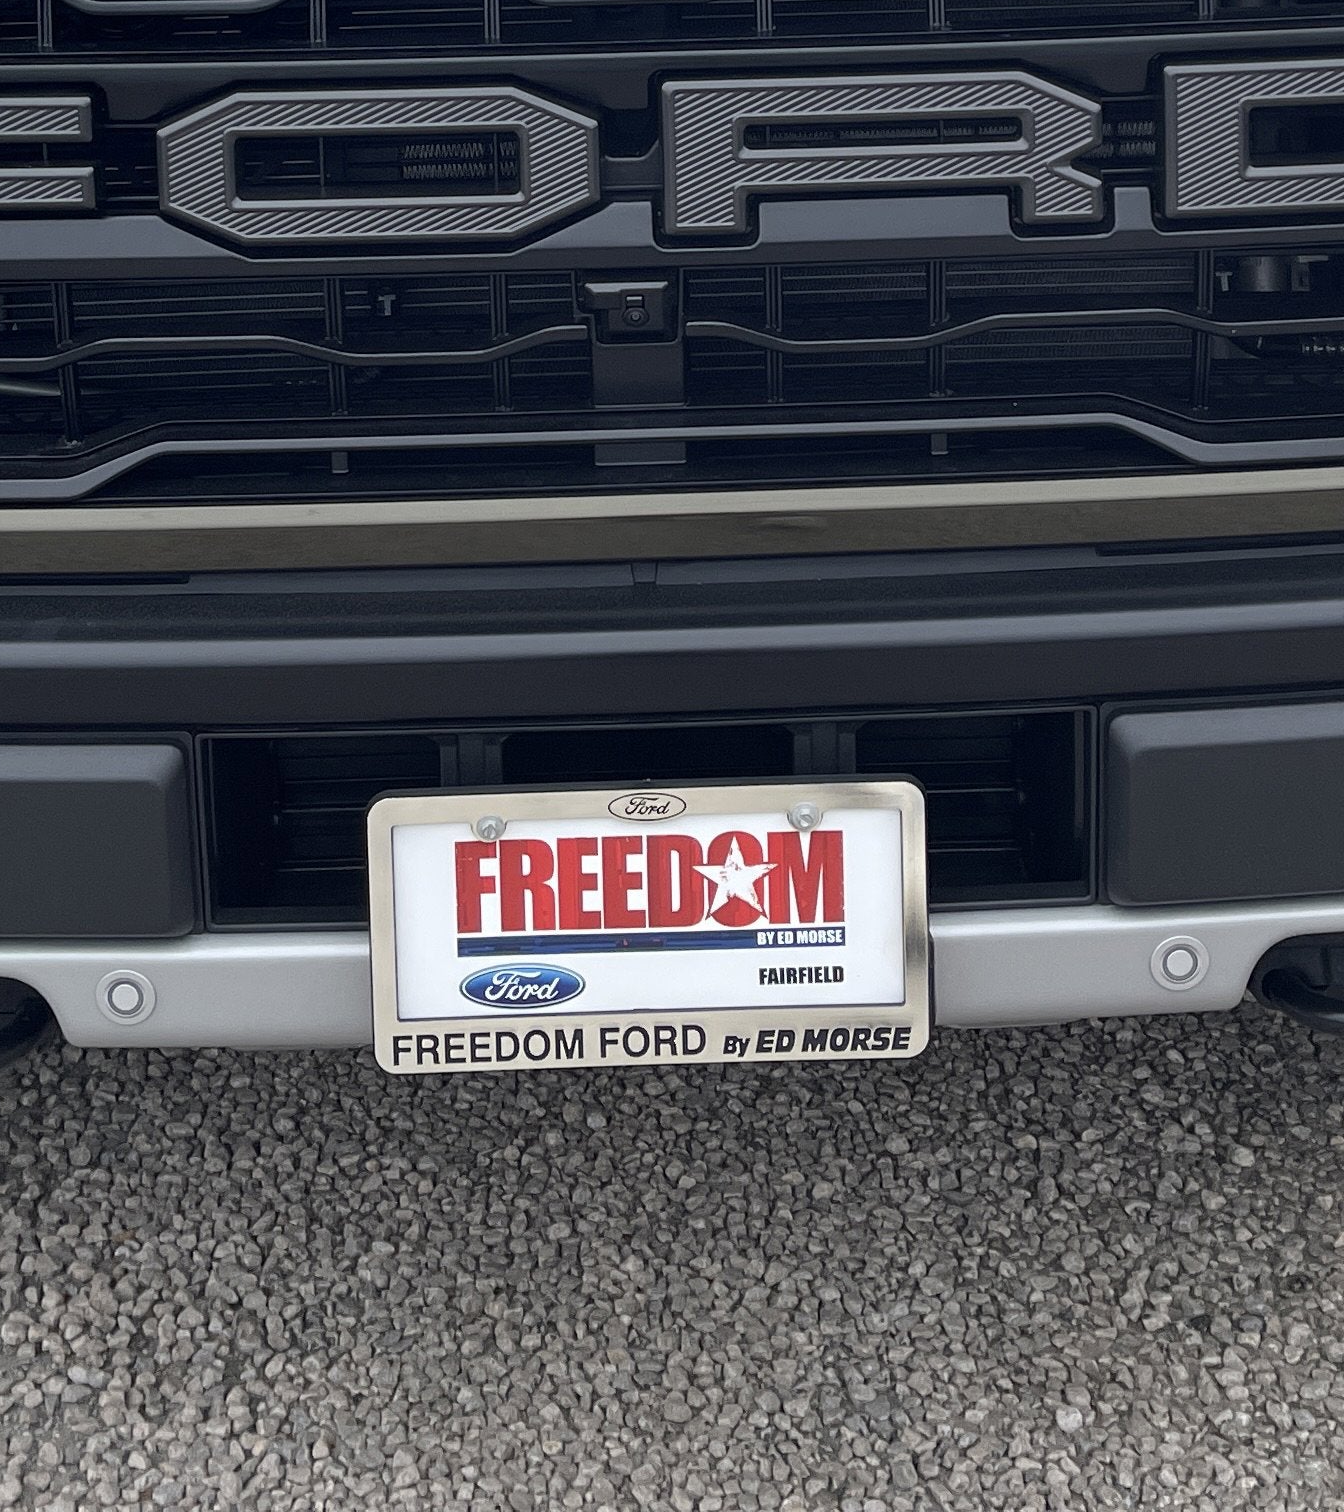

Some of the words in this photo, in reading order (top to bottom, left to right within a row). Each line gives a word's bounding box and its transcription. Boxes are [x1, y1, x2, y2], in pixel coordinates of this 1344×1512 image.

[624, 796, 671, 815] Ford
[455, 830, 846, 934] FREEDOM
[757, 931, 775, 946] BY
[777, 930, 794, 945] ED
[796, 929, 843, 945] MORSE
[484, 970, 561, 1001] Ford
[758, 965, 845, 986] FAIRFIELD
[392, 1027, 584, 1067] FREEDOM
[599, 1024, 706, 1059] FORD
[722, 1035, 751, 1058] By
[755, 1029, 796, 1054] ED
[800, 1026, 912, 1053] MORSE
